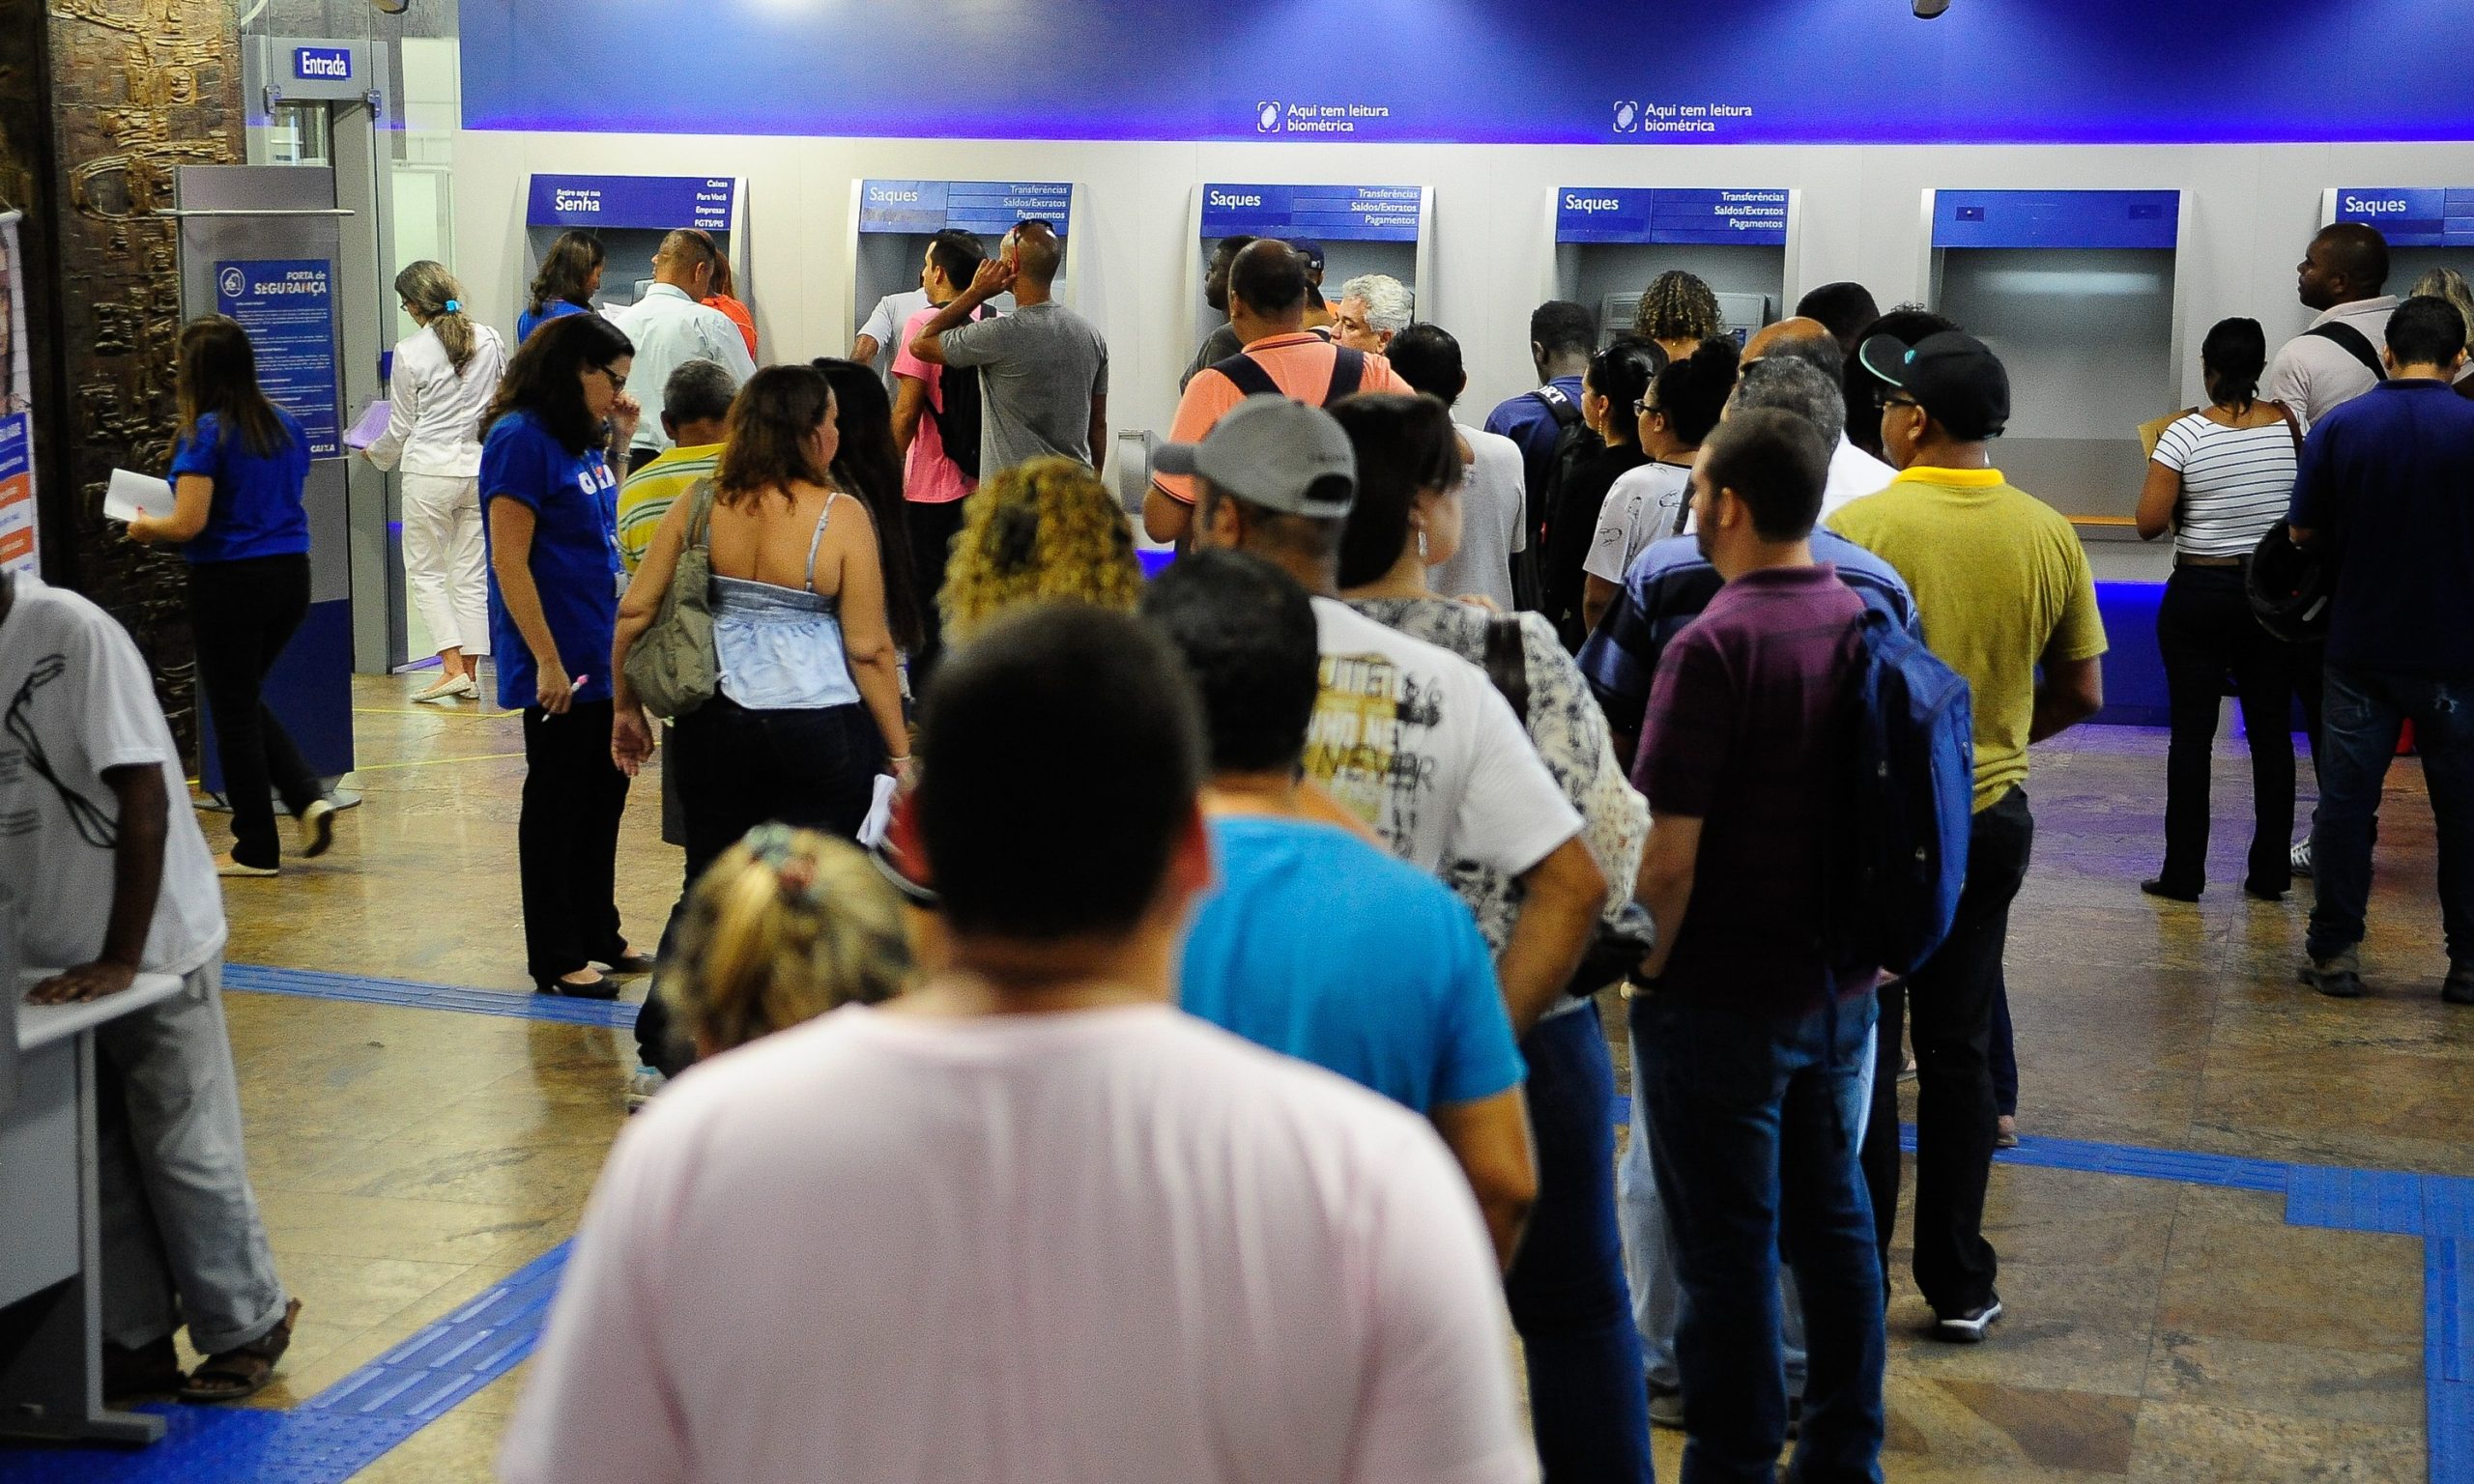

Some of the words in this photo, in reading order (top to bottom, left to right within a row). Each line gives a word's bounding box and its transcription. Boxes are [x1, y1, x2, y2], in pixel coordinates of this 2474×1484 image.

[302, 51, 347, 76] Entrada
[1287, 103, 1317, 120] Aqui
[1320, 105, 1345, 117] tem
[1349, 103, 1389, 117] leitura
[1645, 103, 1677, 120] Aqui
[1680, 105, 1706, 117] tem
[1710, 103, 1752, 117] leitura
[1287, 119, 1354, 131] biométrica
[1645, 118, 1715, 131] biométrica
[576, 189, 590, 198] aqui
[1010, 185, 1067, 193] Transferências
[1358, 188, 1418, 198] Transferências
[711, 192, 727, 201] Você
[869, 186, 918, 205] Saques
[1210, 190, 1261, 210] Saques
[1721, 192, 1785, 201] Transferências
[555, 195, 600, 212] Senha
[1003, 197, 1066, 207] Saldos/Extratos
[1351, 202, 1417, 212] Saldos/Extratos
[1566, 194, 1619, 214] Saques
[2345, 196, 2406, 216] Saques
[695, 205, 726, 214] Empresas
[1017, 210, 1065, 219] Pagamentos
[1713, 206, 1784, 215] Saldos/Extratos
[694, 219, 724, 228] FGTS/PIS
[1365, 214, 1416, 226] Pagamentos
[1729, 218, 1783, 230] Pagamentos
[286, 271, 314, 280] PORTA
[315, 271, 327, 280] de
[254, 281, 327, 297] SEGURANÇA
[309, 443, 335, 453] CAIXA
